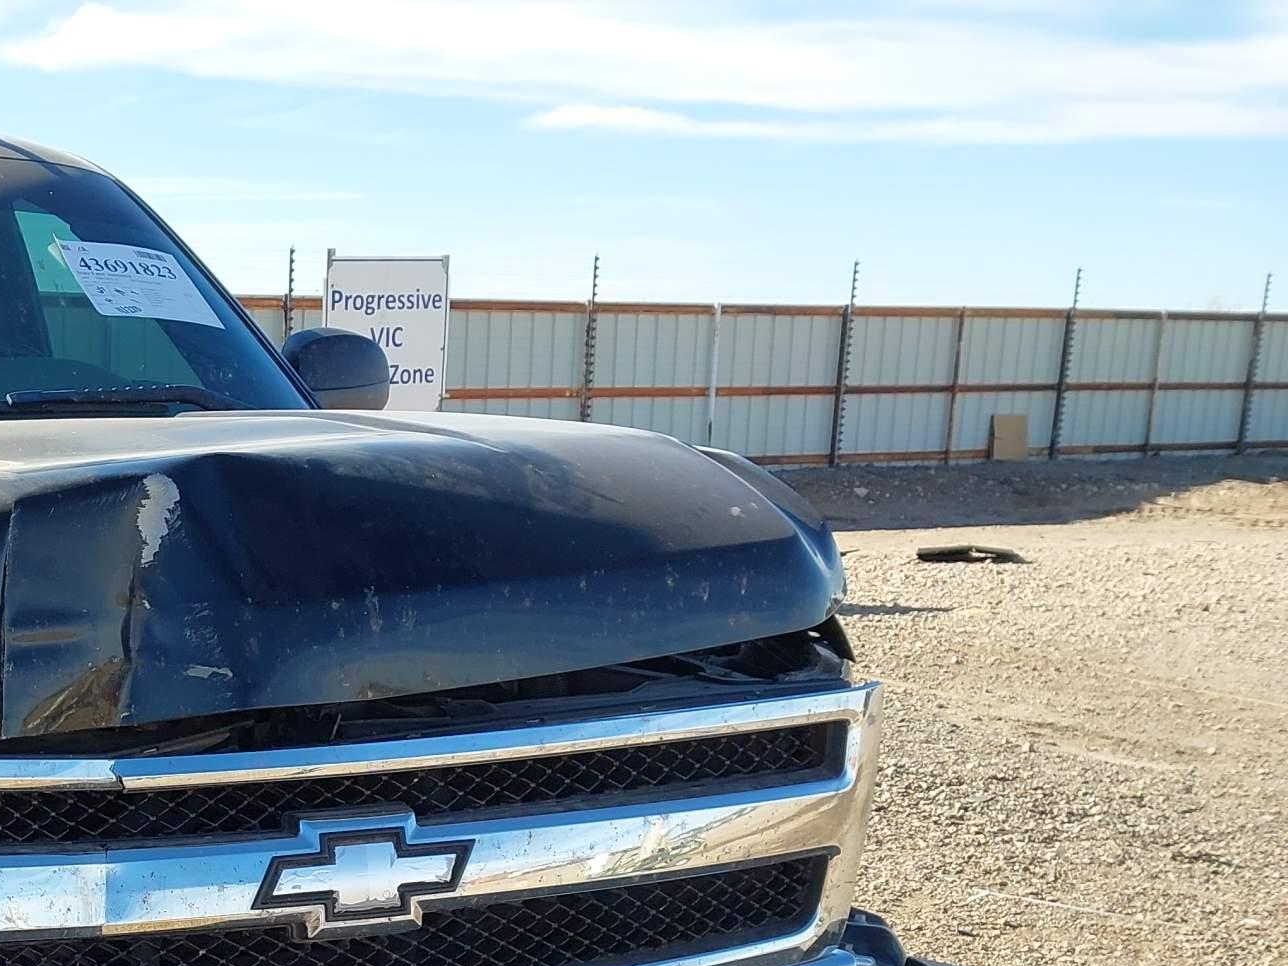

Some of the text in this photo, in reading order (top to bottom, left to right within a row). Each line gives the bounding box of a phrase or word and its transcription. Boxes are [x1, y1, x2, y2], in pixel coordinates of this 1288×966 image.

[79, 256, 178, 280] 43691823
[331, 288, 443, 316] Progressive
[370, 327, 404, 348] VIC
[389, 365, 435, 384] Zone
